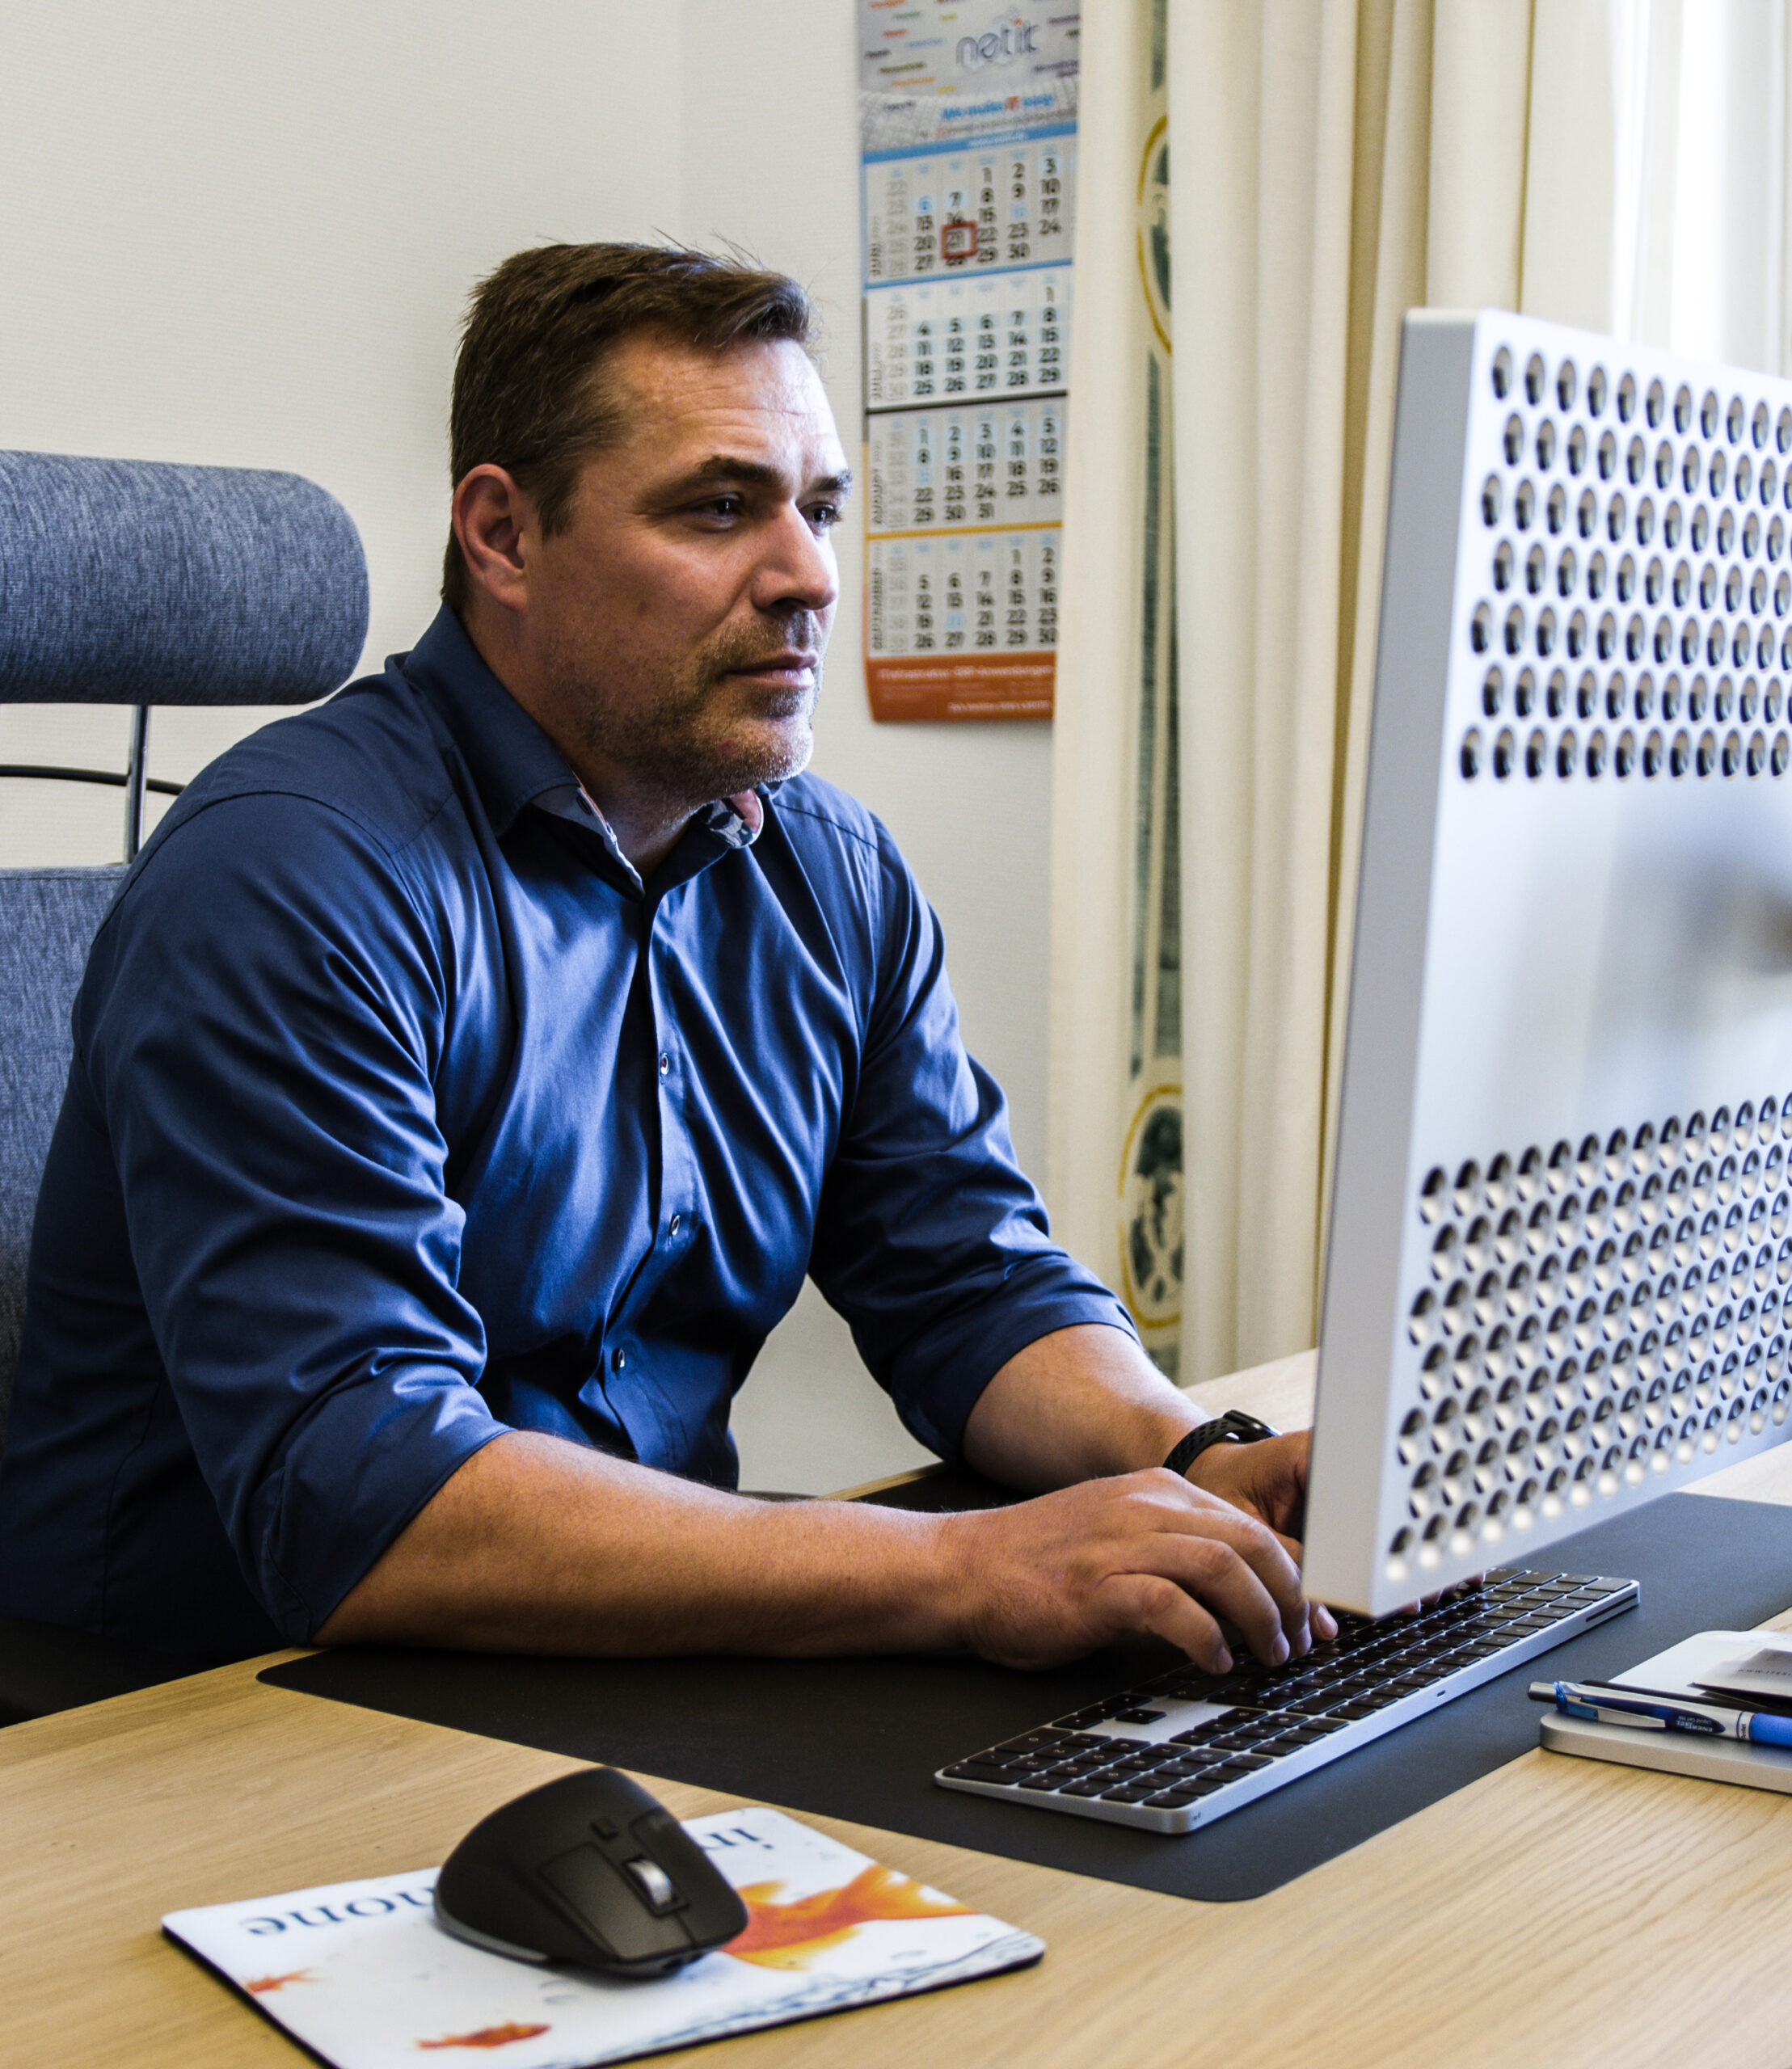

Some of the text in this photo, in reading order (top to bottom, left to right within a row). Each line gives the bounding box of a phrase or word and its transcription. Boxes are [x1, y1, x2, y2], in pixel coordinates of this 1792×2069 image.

[984, 168, 991, 182] 1
[1013, 163, 1025, 179] 2
[1046, 158, 1056, 174] 3
[950, 192, 961, 207] 7
[981, 188, 993, 202] 8
[1013, 183, 1025, 198] 9
[1042, 179, 1060, 194] 10
[917, 216, 932, 230] 13
[980, 208, 995, 222] 15
[1042, 198, 1059, 214] 17
[915, 236, 935, 251] 20
[948, 231, 963, 247] 21
[978, 228, 997, 242] 22
[1010, 223, 1027, 238] 23
[1039, 219, 1060, 234] 24
[915, 255, 933, 271] 27
[977, 248, 997, 263] 29
[1010, 243, 1029, 259] 30
[1047, 287, 1053, 302] 1
[919, 322, 930, 335] 4
[951, 318, 960, 332] 5
[981, 314, 993, 329] 6
[1013, 311, 1024, 325] 7
[1044, 307, 1056, 322] 8
[919, 341, 930, 356] 11
[948, 338, 963, 352] 12
[980, 335, 994, 349] 13
[1010, 331, 1027, 345] 14
[1042, 327, 1058, 343] 15
[917, 360, 933, 375] 18
[947, 357, 963, 372] 19
[976, 354, 997, 369] 20
[1010, 351, 1026, 365] 21
[1039, 348, 1059, 362] 22
[915, 380, 933, 394] 25
[946, 377, 964, 392] 26
[976, 374, 996, 390] 27
[1009, 371, 1027, 386] 28
[1039, 368, 1060, 382] 29
[921, 418, 1055, 444] 1 2 3 4 5
[918, 438, 1057, 464] 8 9 10 11 12
[947, 466, 963, 480] 16
[979, 463, 994, 478] 17
[1010, 461, 1026, 475] 18
[1041, 458, 1058, 473] 19
[915, 478, 1060, 502] 22 23 24 25 26
[915, 503, 994, 522] 29 30 31
[1013, 547, 1054, 564] 1 2
[919, 567, 1054, 589] 5 6 7 8 9
[917, 588, 1056, 609] 12 13 14 15 16
[918, 614, 932, 629] 19
[980, 611, 993, 626] 21
[1007, 609, 1027, 624] 22
[1039, 608, 1056, 624] 23
[915, 628, 1057, 648] 26 27 28 29 30
